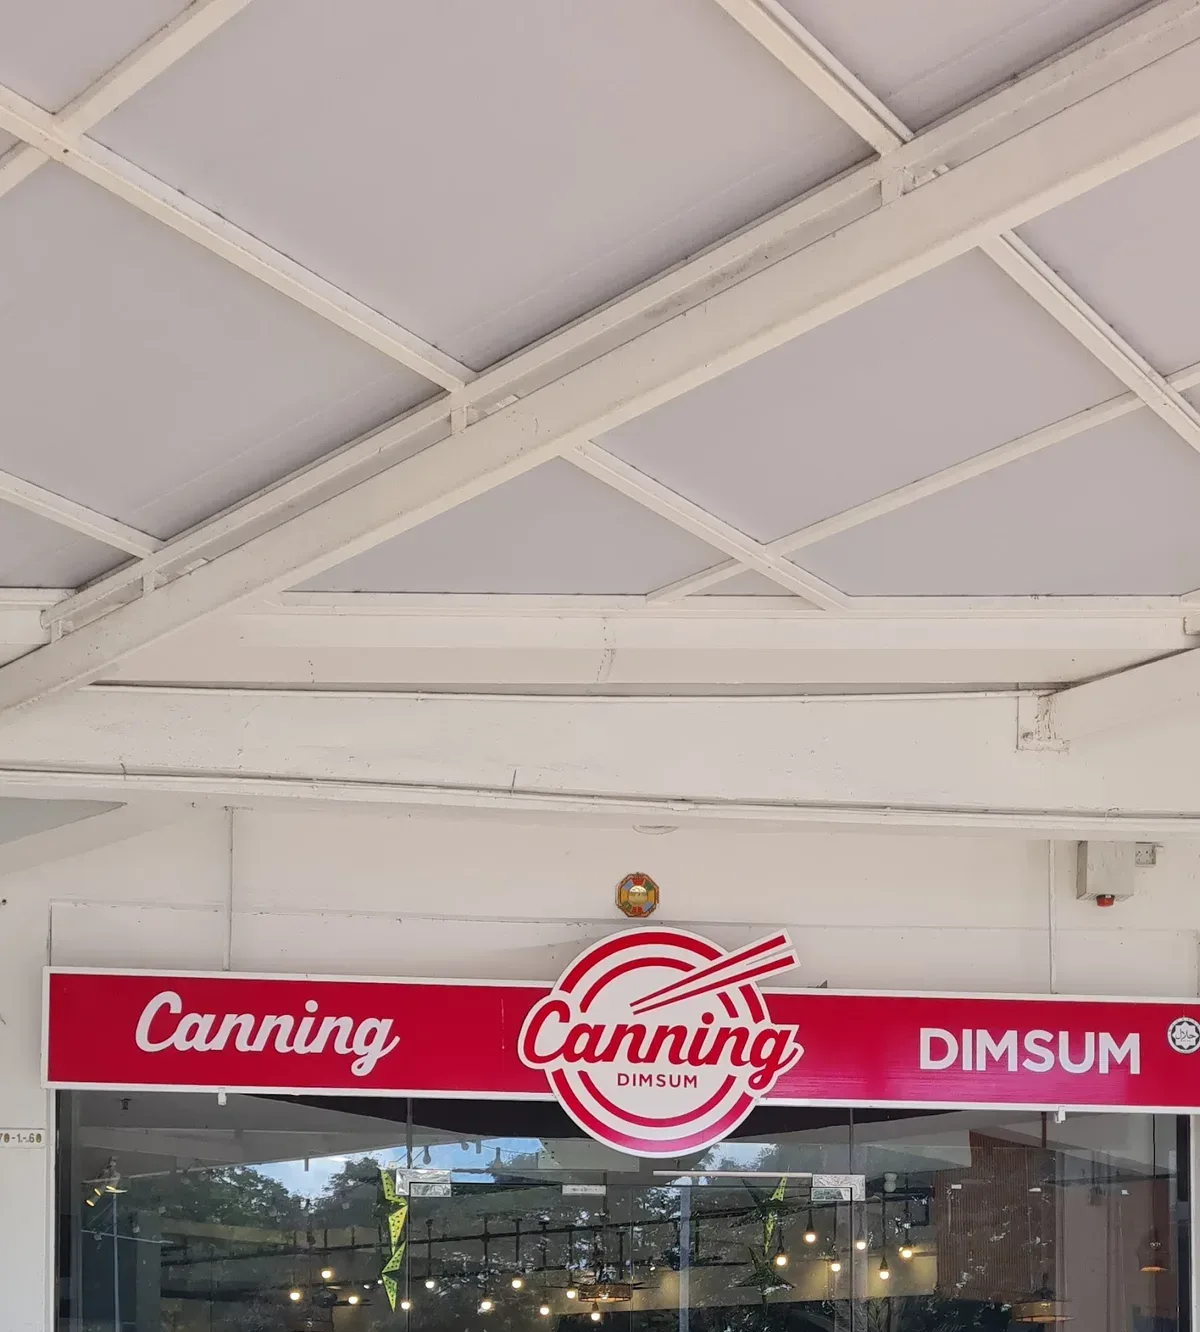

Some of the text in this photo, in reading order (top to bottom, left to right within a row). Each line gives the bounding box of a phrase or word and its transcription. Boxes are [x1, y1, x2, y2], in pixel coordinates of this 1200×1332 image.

[135, 990, 401, 1077] Canning
[522, 999, 800, 1091] Canning
[919, 1027, 1141, 1075] DIMSUM
[617, 1073, 698, 1089] DIMSUM
